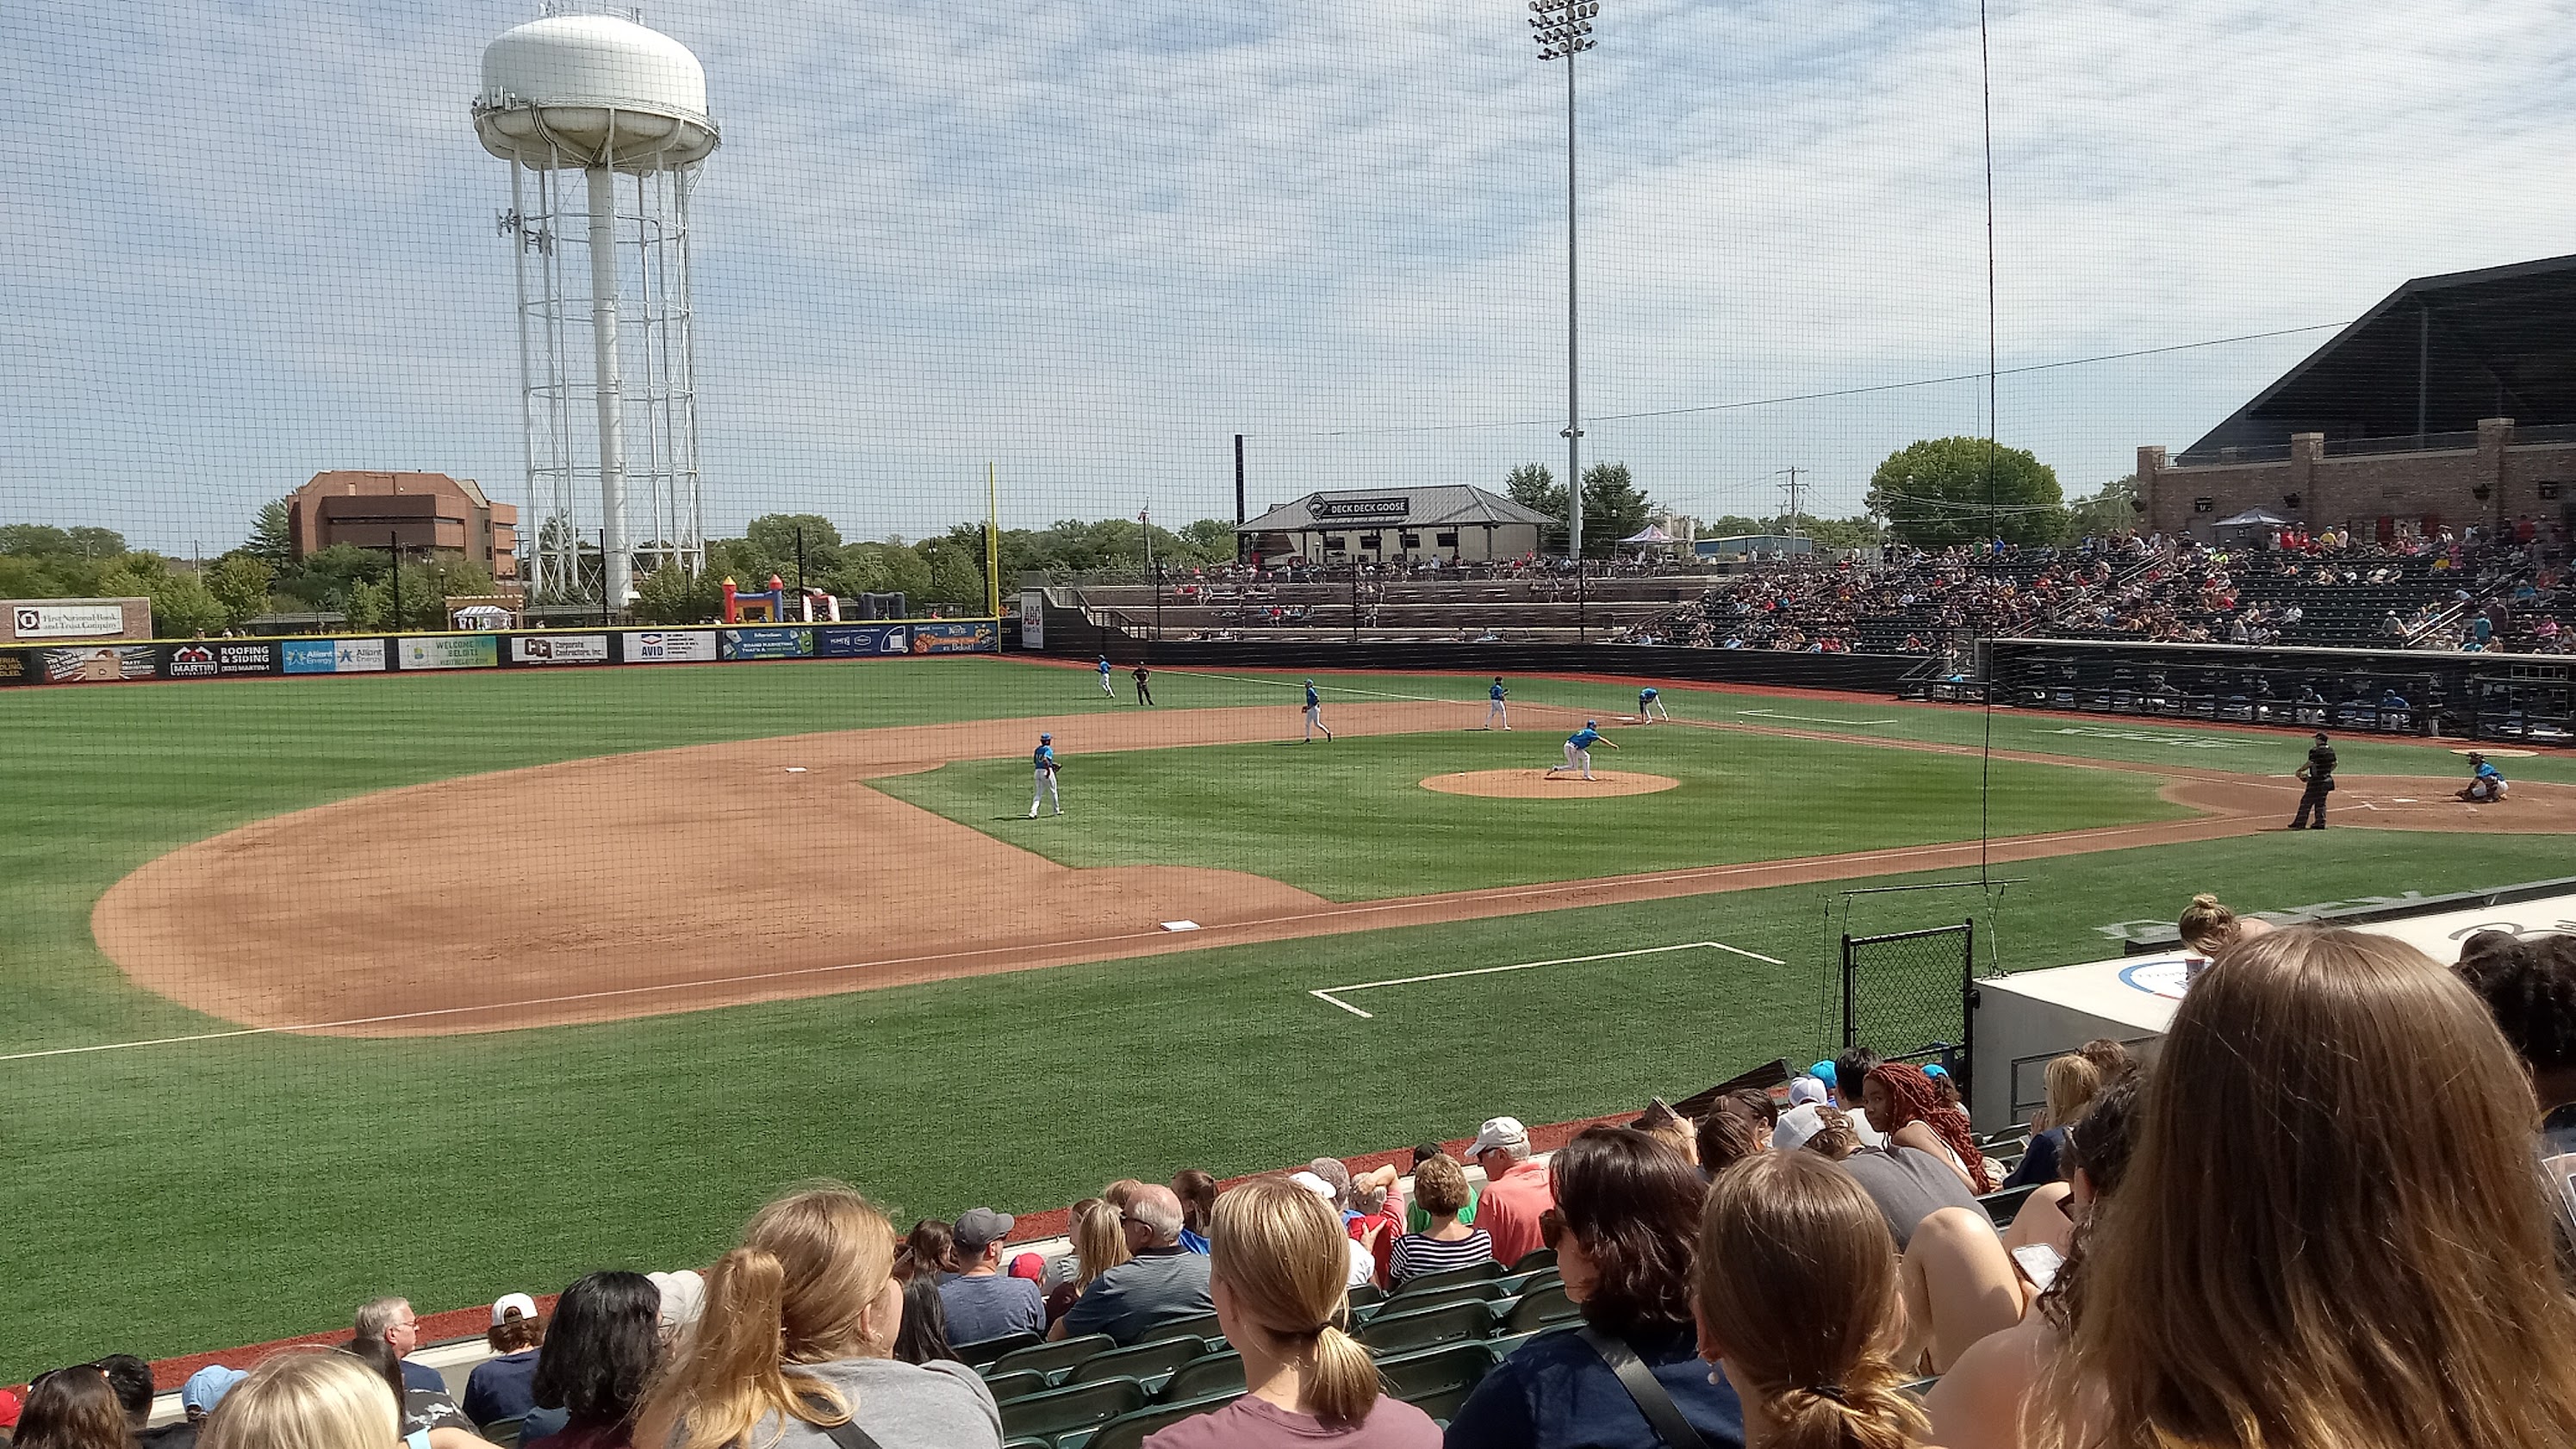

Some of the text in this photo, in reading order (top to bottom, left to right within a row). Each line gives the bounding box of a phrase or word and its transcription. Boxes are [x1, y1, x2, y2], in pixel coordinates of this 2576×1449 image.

[1331, 502, 1405, 513] DECK DECK GOOSE
[62, 613, 96, 622] National
[1024, 606, 1041, 625] ABC
[436, 641, 473, 650] WELCOME
[221, 646, 270, 655] ROOFING
[642, 646, 663, 656] AVID
[232, 655, 270, 663] SIDING
[174, 664, 214, 673] MARTIN
